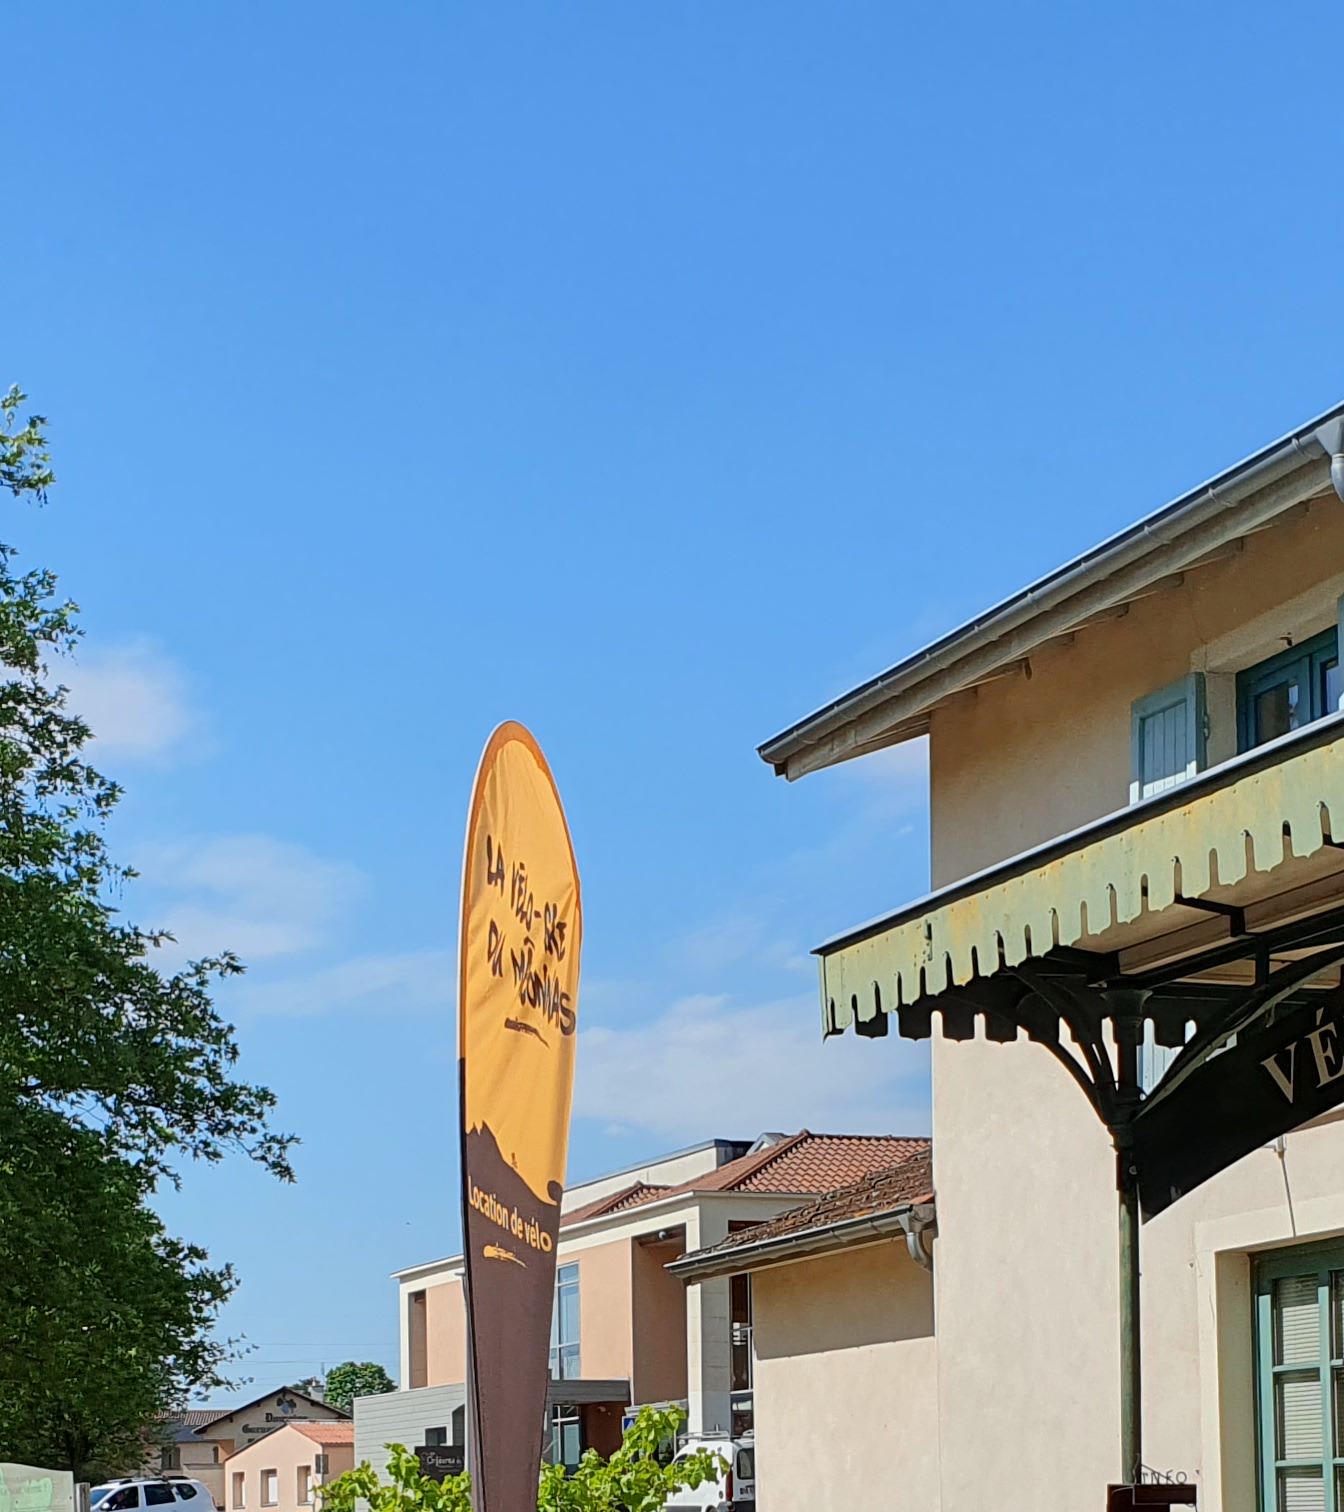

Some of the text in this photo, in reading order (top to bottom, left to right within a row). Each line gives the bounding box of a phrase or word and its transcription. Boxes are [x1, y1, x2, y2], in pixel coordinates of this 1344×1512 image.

[486, 833, 506, 898] LA
[467, 1175, 553, 1252] Location de vélo
